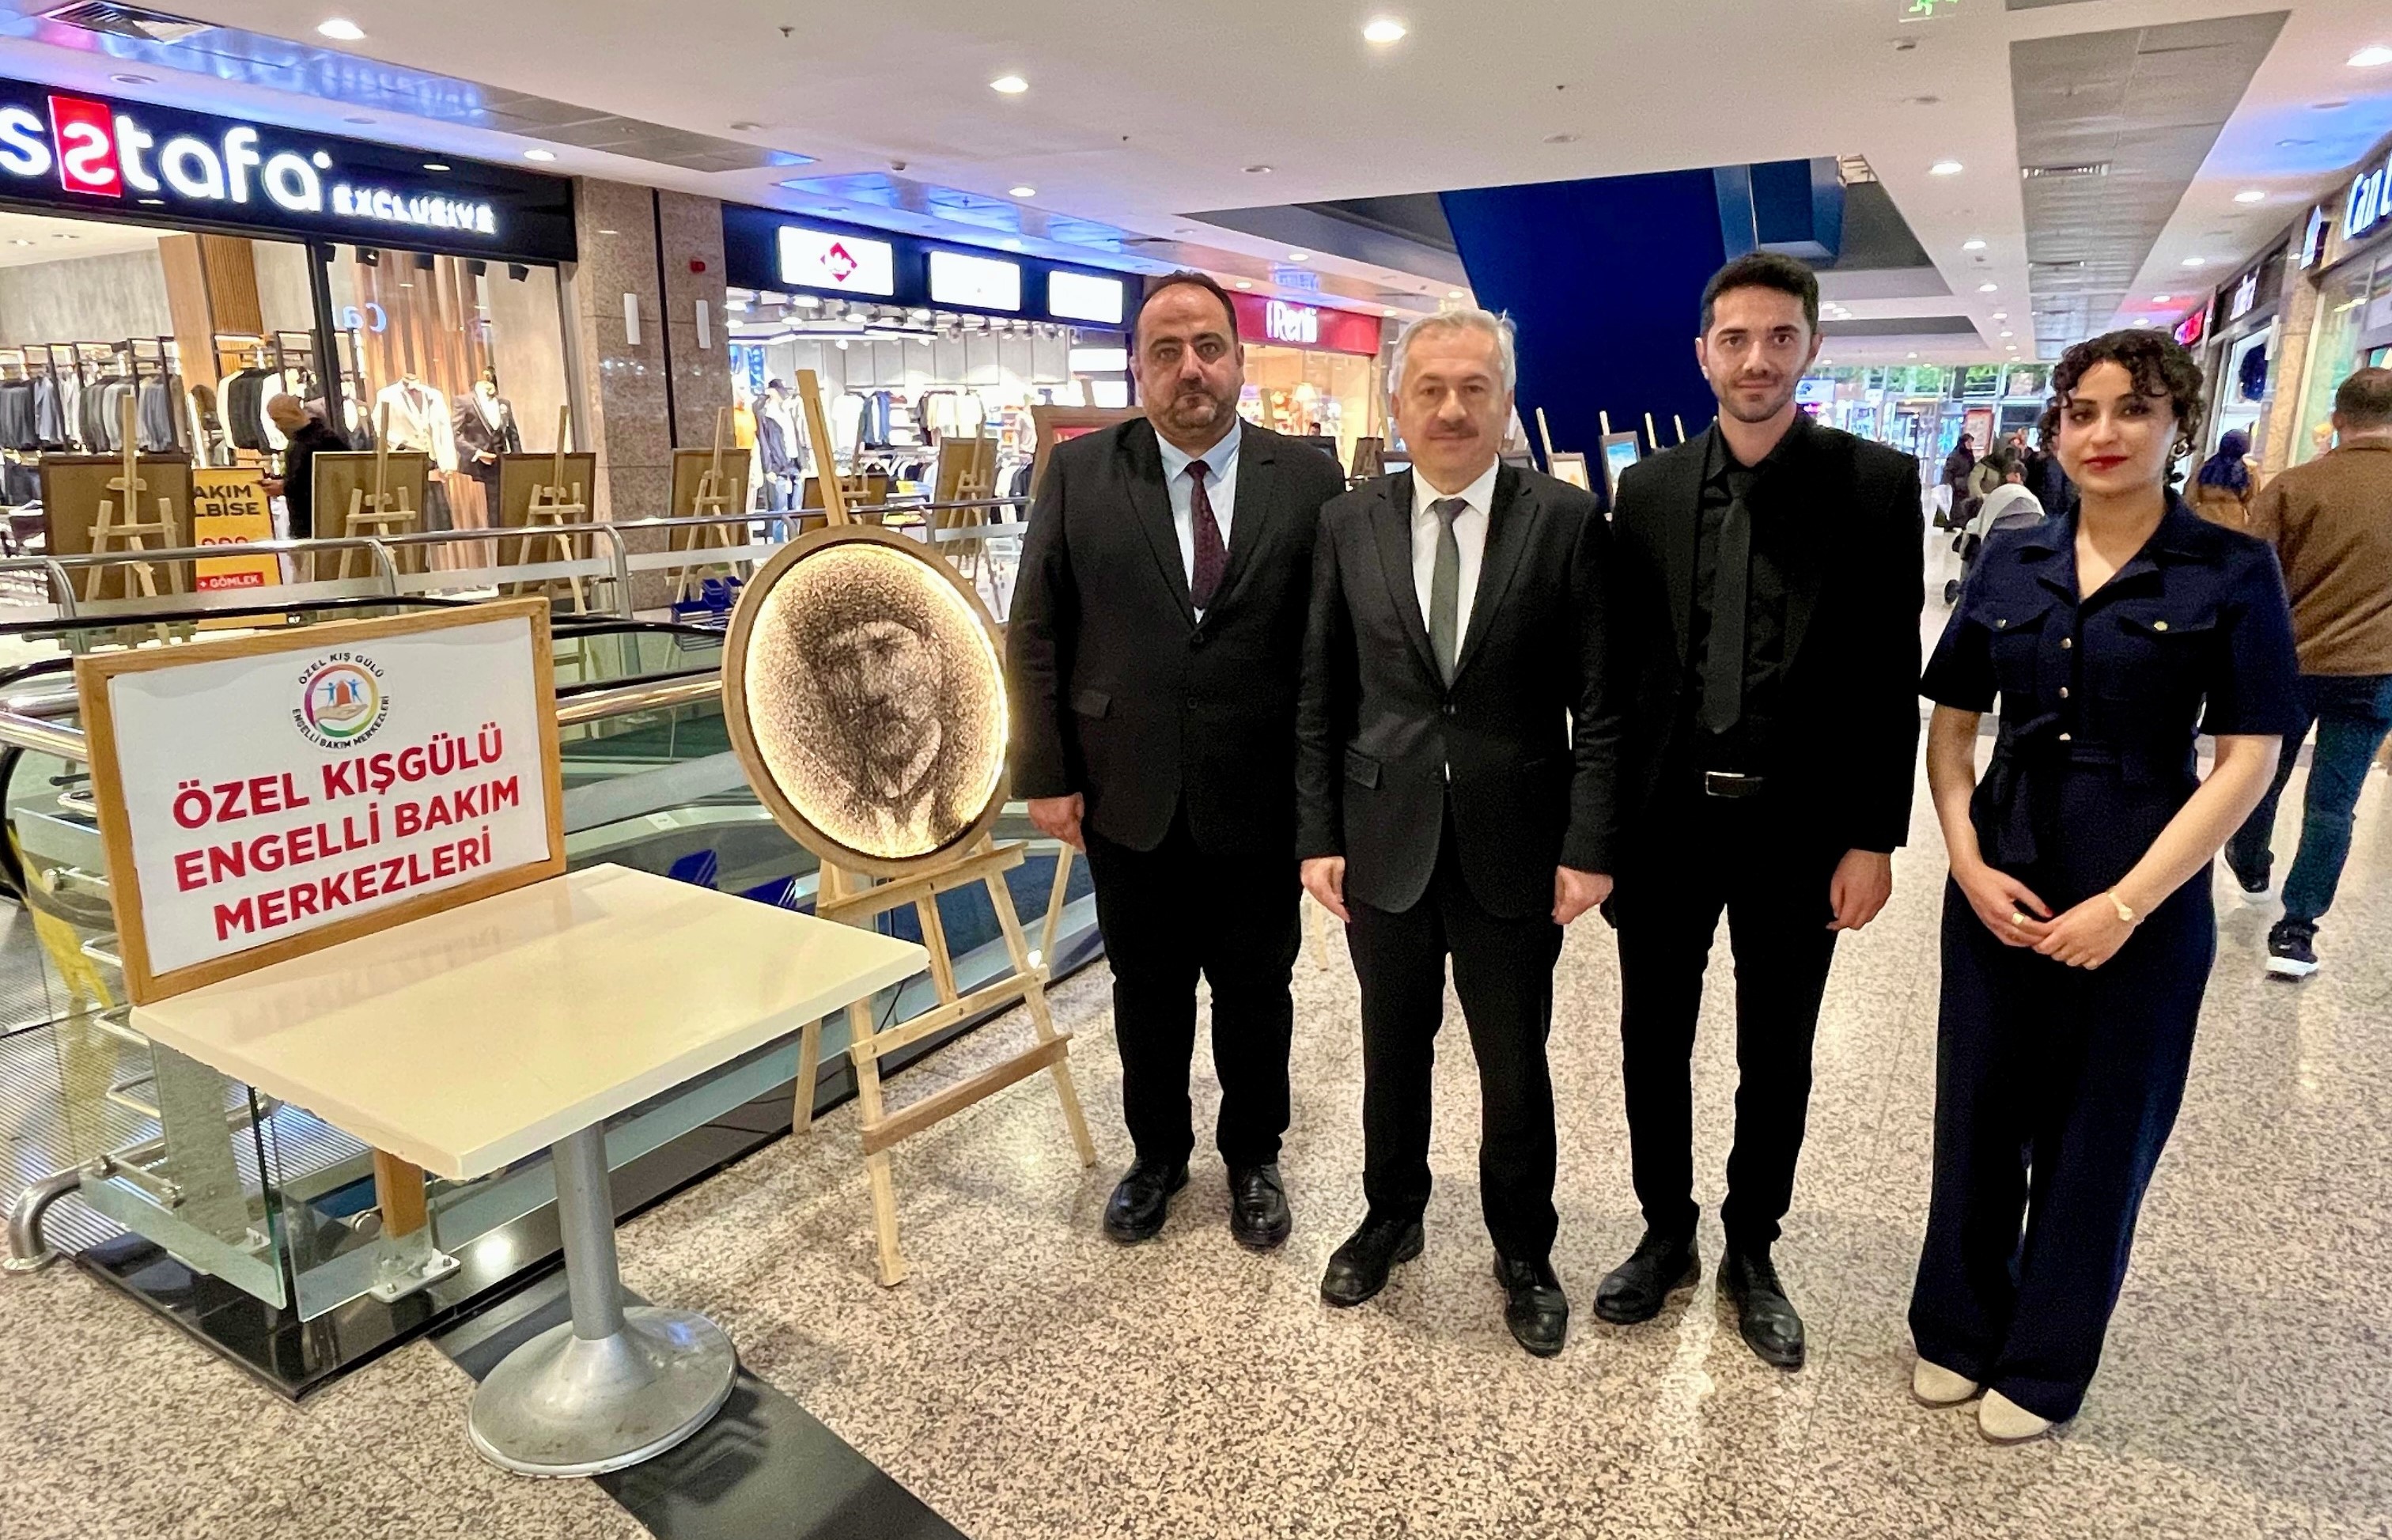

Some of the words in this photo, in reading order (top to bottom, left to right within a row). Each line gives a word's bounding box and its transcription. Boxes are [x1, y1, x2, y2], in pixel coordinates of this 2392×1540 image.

[332, 184, 496, 235] EXCLUSIVE
[209, 574, 259, 588] GÖMLEK
[297, 659, 327, 685] ÖZEL
[329, 653, 351, 663] KIŞ
[354, 654, 385, 678] GÜLÜ
[292, 708, 321, 744] ENGELLİ
[319, 737, 352, 750] BAKIM
[172, 772, 310, 829] ÖZEL
[321, 721, 502, 801] KIŞGÜLÜ
[174, 801, 380, 893] ENGELLİ
[395, 774, 520, 838] BAKIM
[214, 824, 492, 941] MERKEZLERİ
